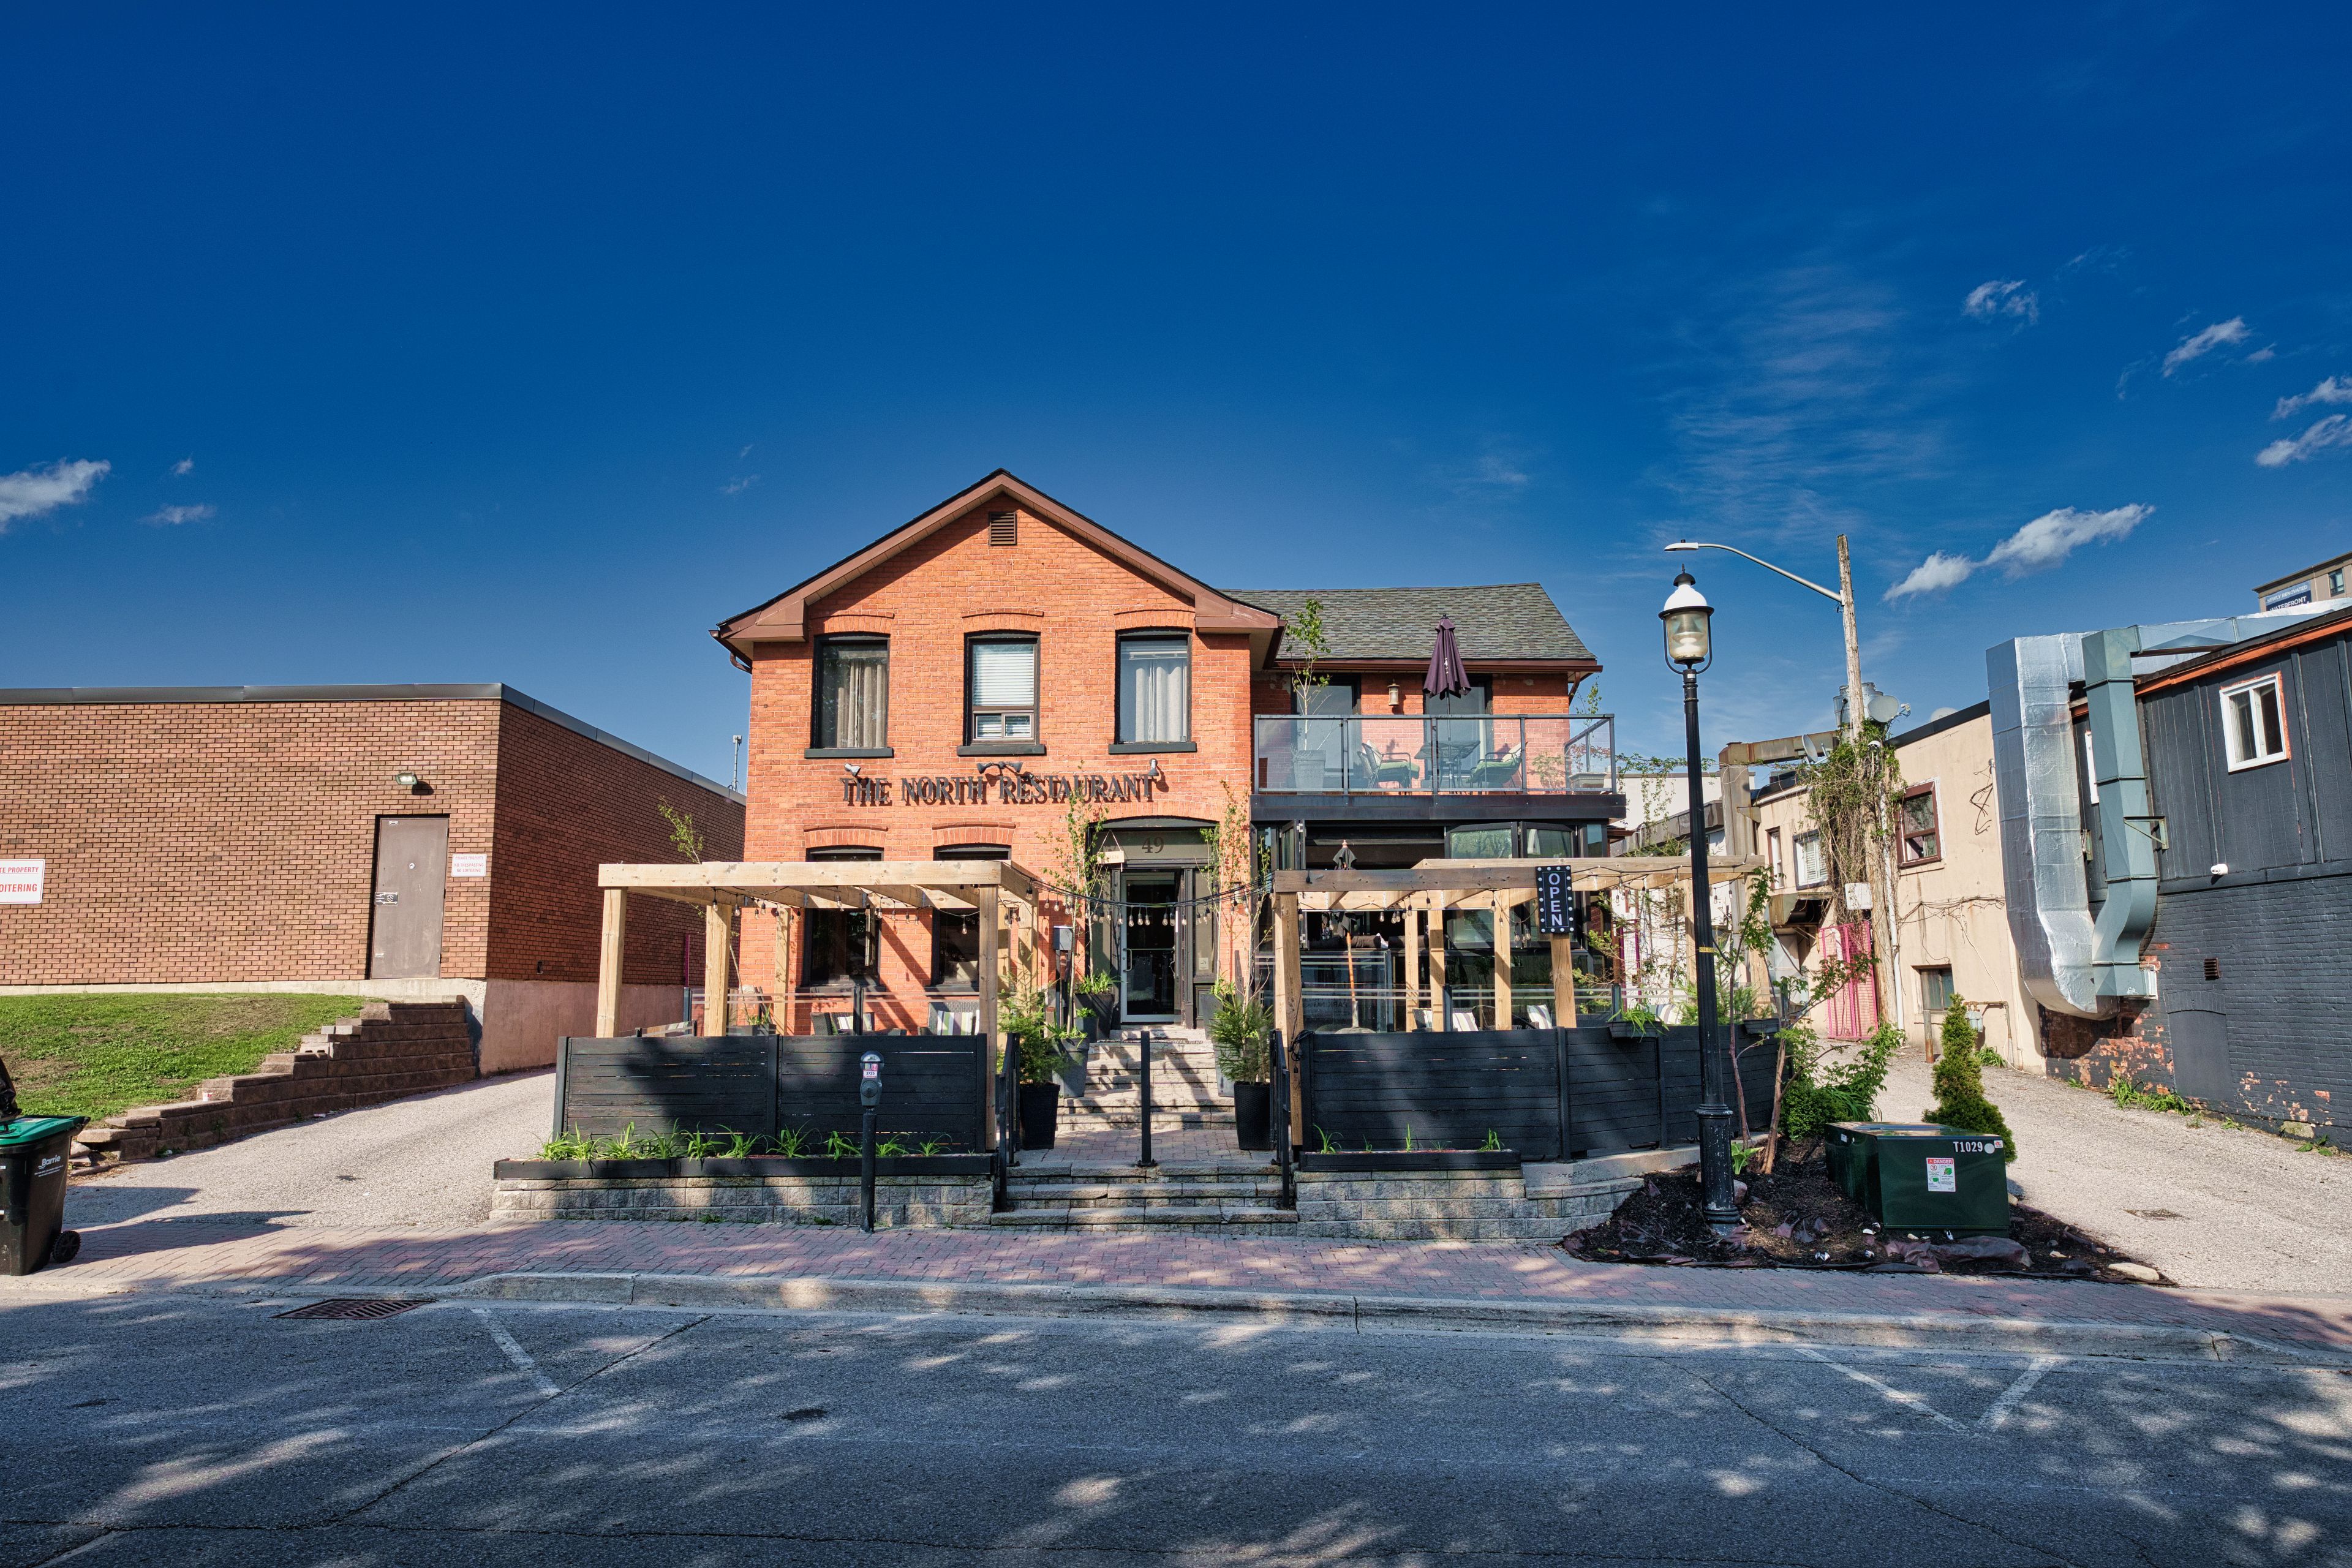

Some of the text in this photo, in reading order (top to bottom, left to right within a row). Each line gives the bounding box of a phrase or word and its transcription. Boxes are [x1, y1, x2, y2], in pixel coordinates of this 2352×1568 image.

[2282, 585, 2308, 597] RENOVATED
[840, 774, 1154, 802] THE NORTH RESTAURANT
[1142, 837, 1164, 854] 49
[1548, 873, 1562, 926] OPEN
[1953, 1141, 1983, 1152] T1029
[42, 1155, 61, 1166] Barrie
